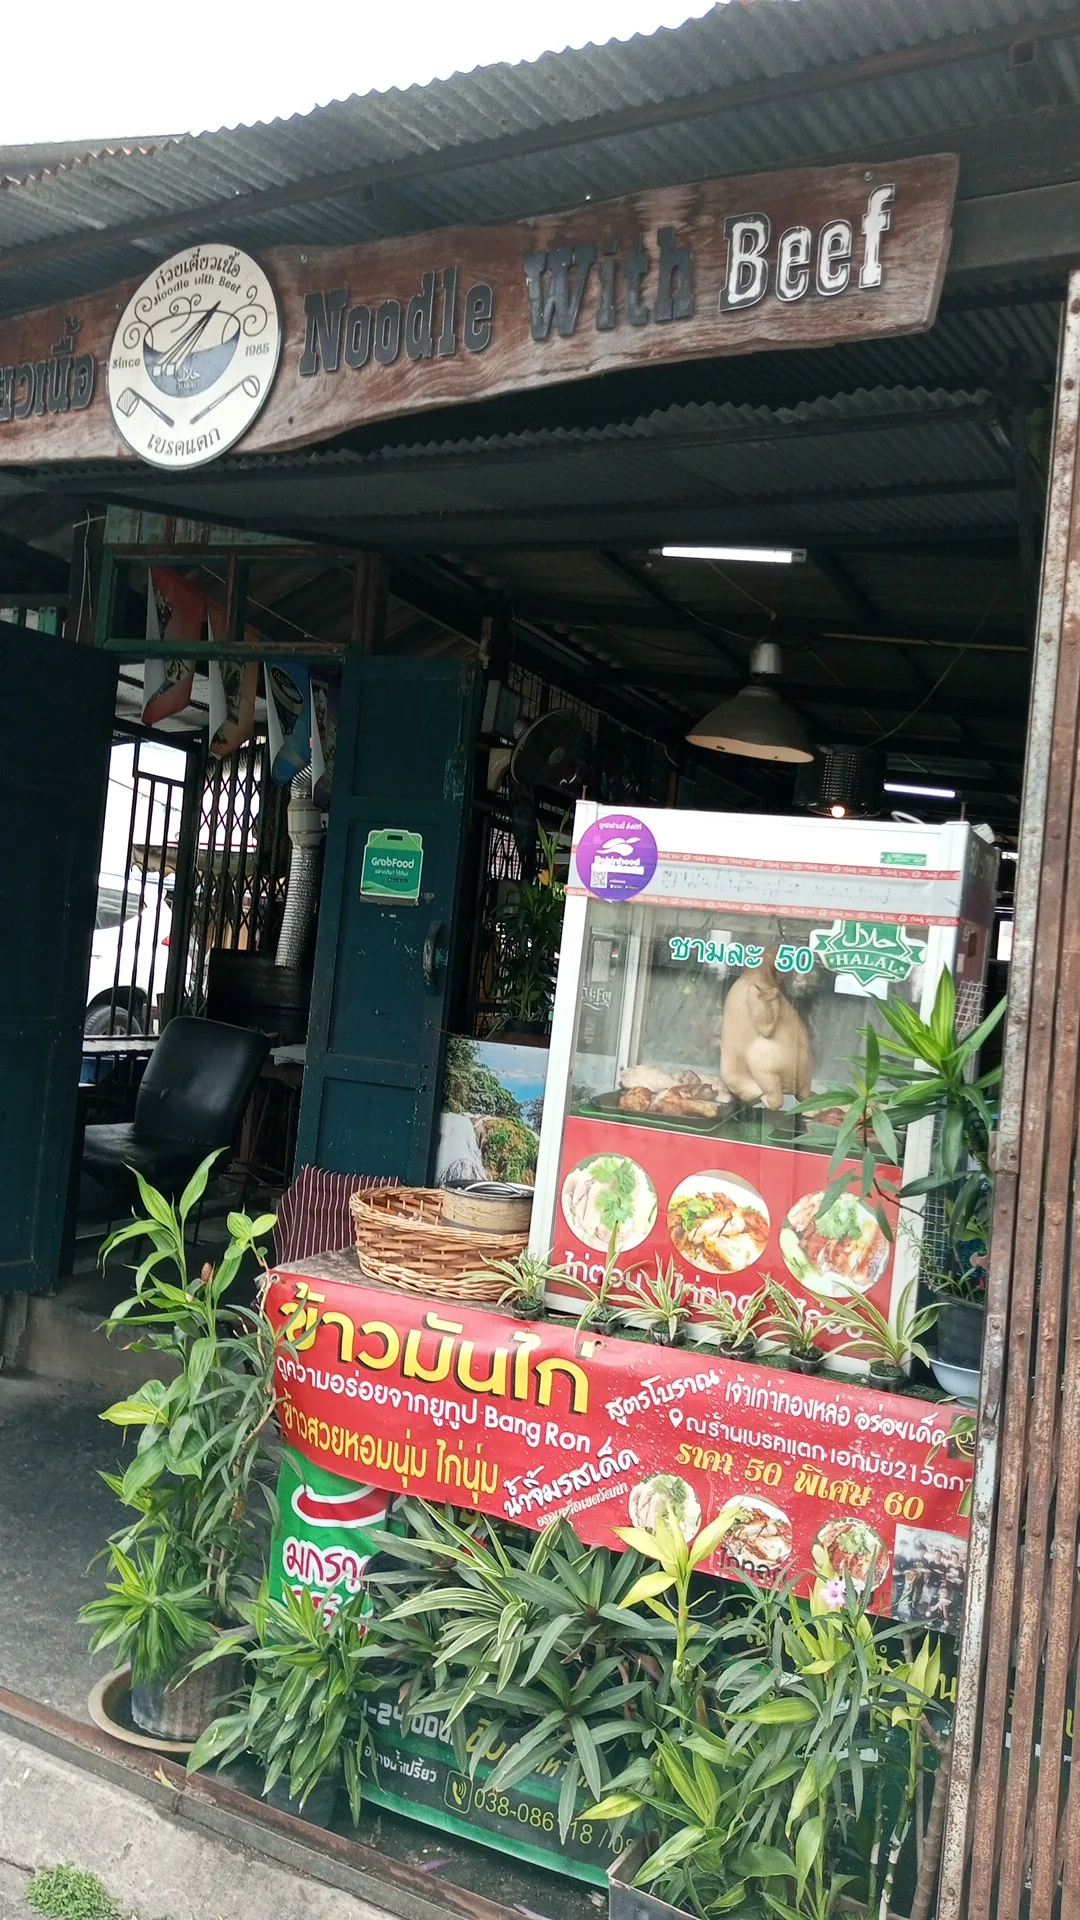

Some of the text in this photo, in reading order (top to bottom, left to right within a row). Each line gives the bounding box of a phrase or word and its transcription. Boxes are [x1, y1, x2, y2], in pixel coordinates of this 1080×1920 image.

[300, 183, 895, 375] Noodle With Beef
[244, 343, 270, 357] 1985
[371, 856, 415, 869] GrabFood
[669, 936, 814, 973] ชามละ 50
[835, 951, 898, 972] HALAL
[842, 922, 898, 948] حلال
[280, 1282, 596, 1414] ข้าวมันไก่
[276, 1355, 591, 1454] ดูความอร่อยจากยูทูป Bang Ron
[605, 1369, 721, 1427] สูตรโบราณ
[725, 1374, 948, 1448] เจ้าเก่าทองหล่อ อร่อยเด็ด
[283, 1388, 500, 1505] ข้าวสวยหอมนุ่ม ไก่นุ่ม
[503, 1436, 640, 1518] น้ำจิ้มรสเด็ด
[676, 1443, 925, 1521] ราคา 50 พิเศษ 60
[286, 1543, 367, 1589] มกรา
[474, 1788, 594, 1844] 038-08618
